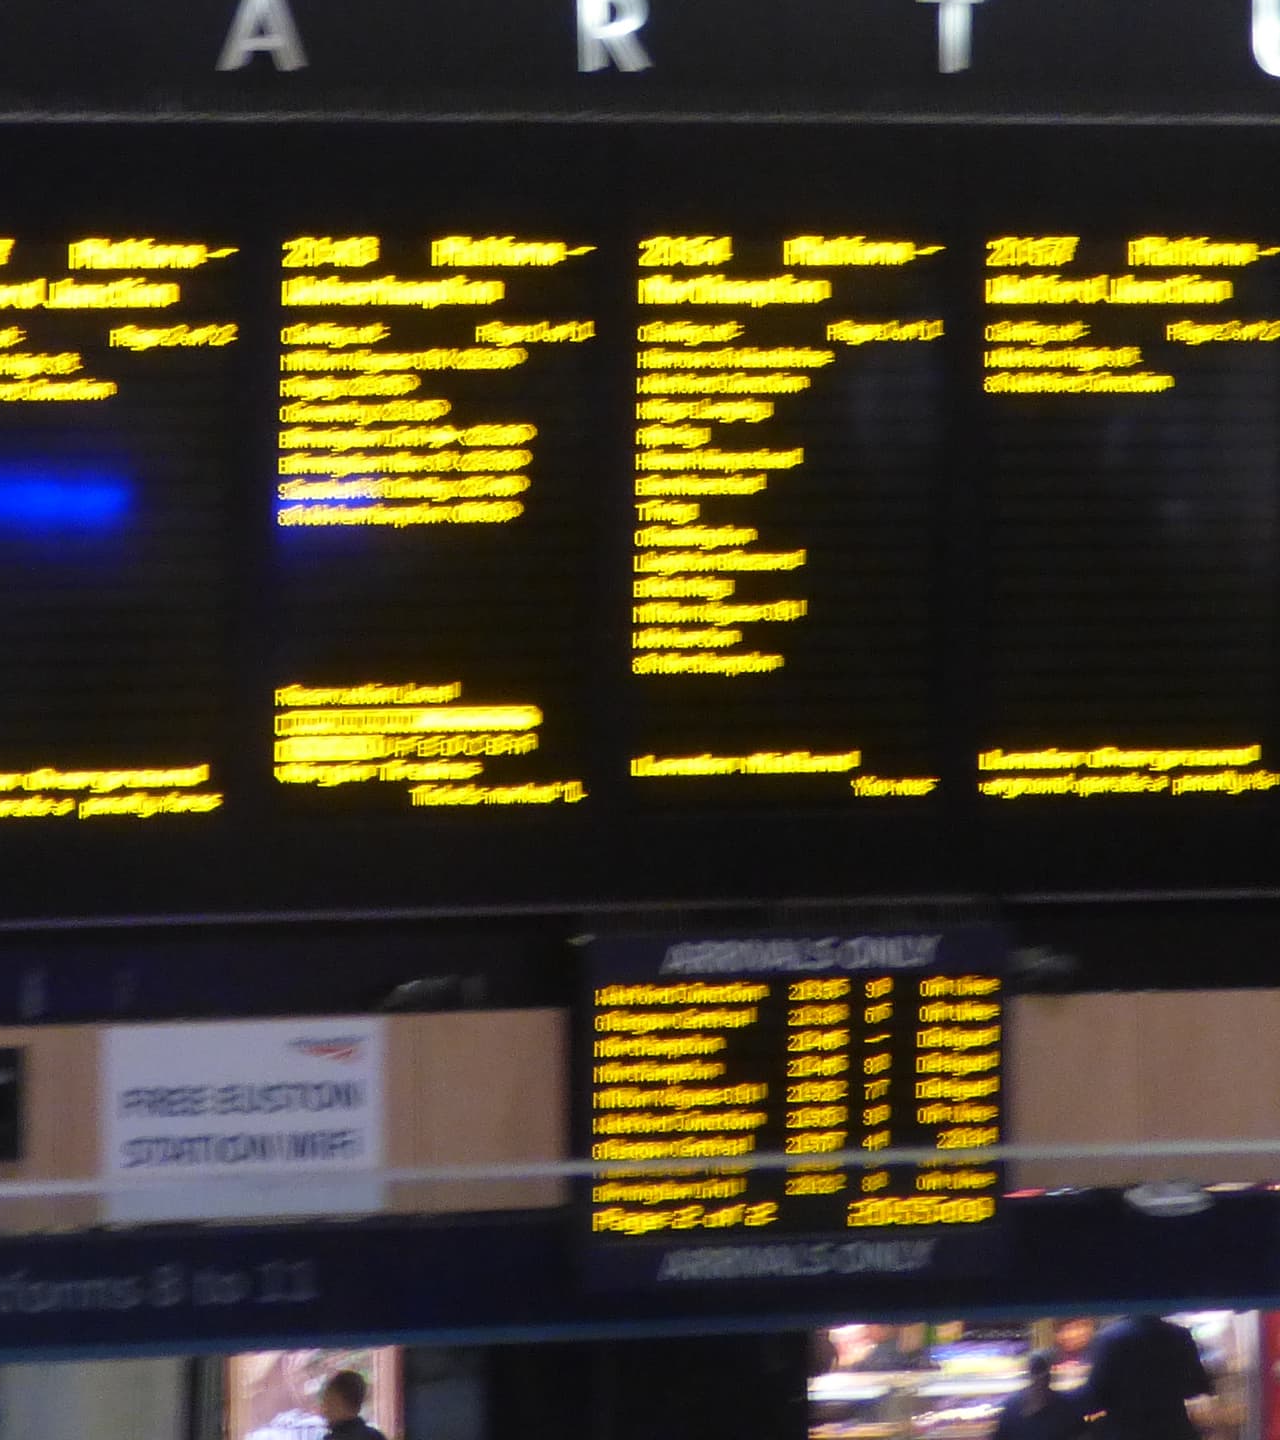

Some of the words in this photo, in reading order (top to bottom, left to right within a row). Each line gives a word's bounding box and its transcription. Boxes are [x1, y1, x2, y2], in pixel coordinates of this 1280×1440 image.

[122, 1086, 205, 1117] FREE
[218, 1079, 361, 1114] EUSTON
[121, 1133, 270, 1168] STATION
[593, 1203, 673, 1234] Page
[191, 1268, 251, 1306] to
[258, 1263, 317, 1304] 11
